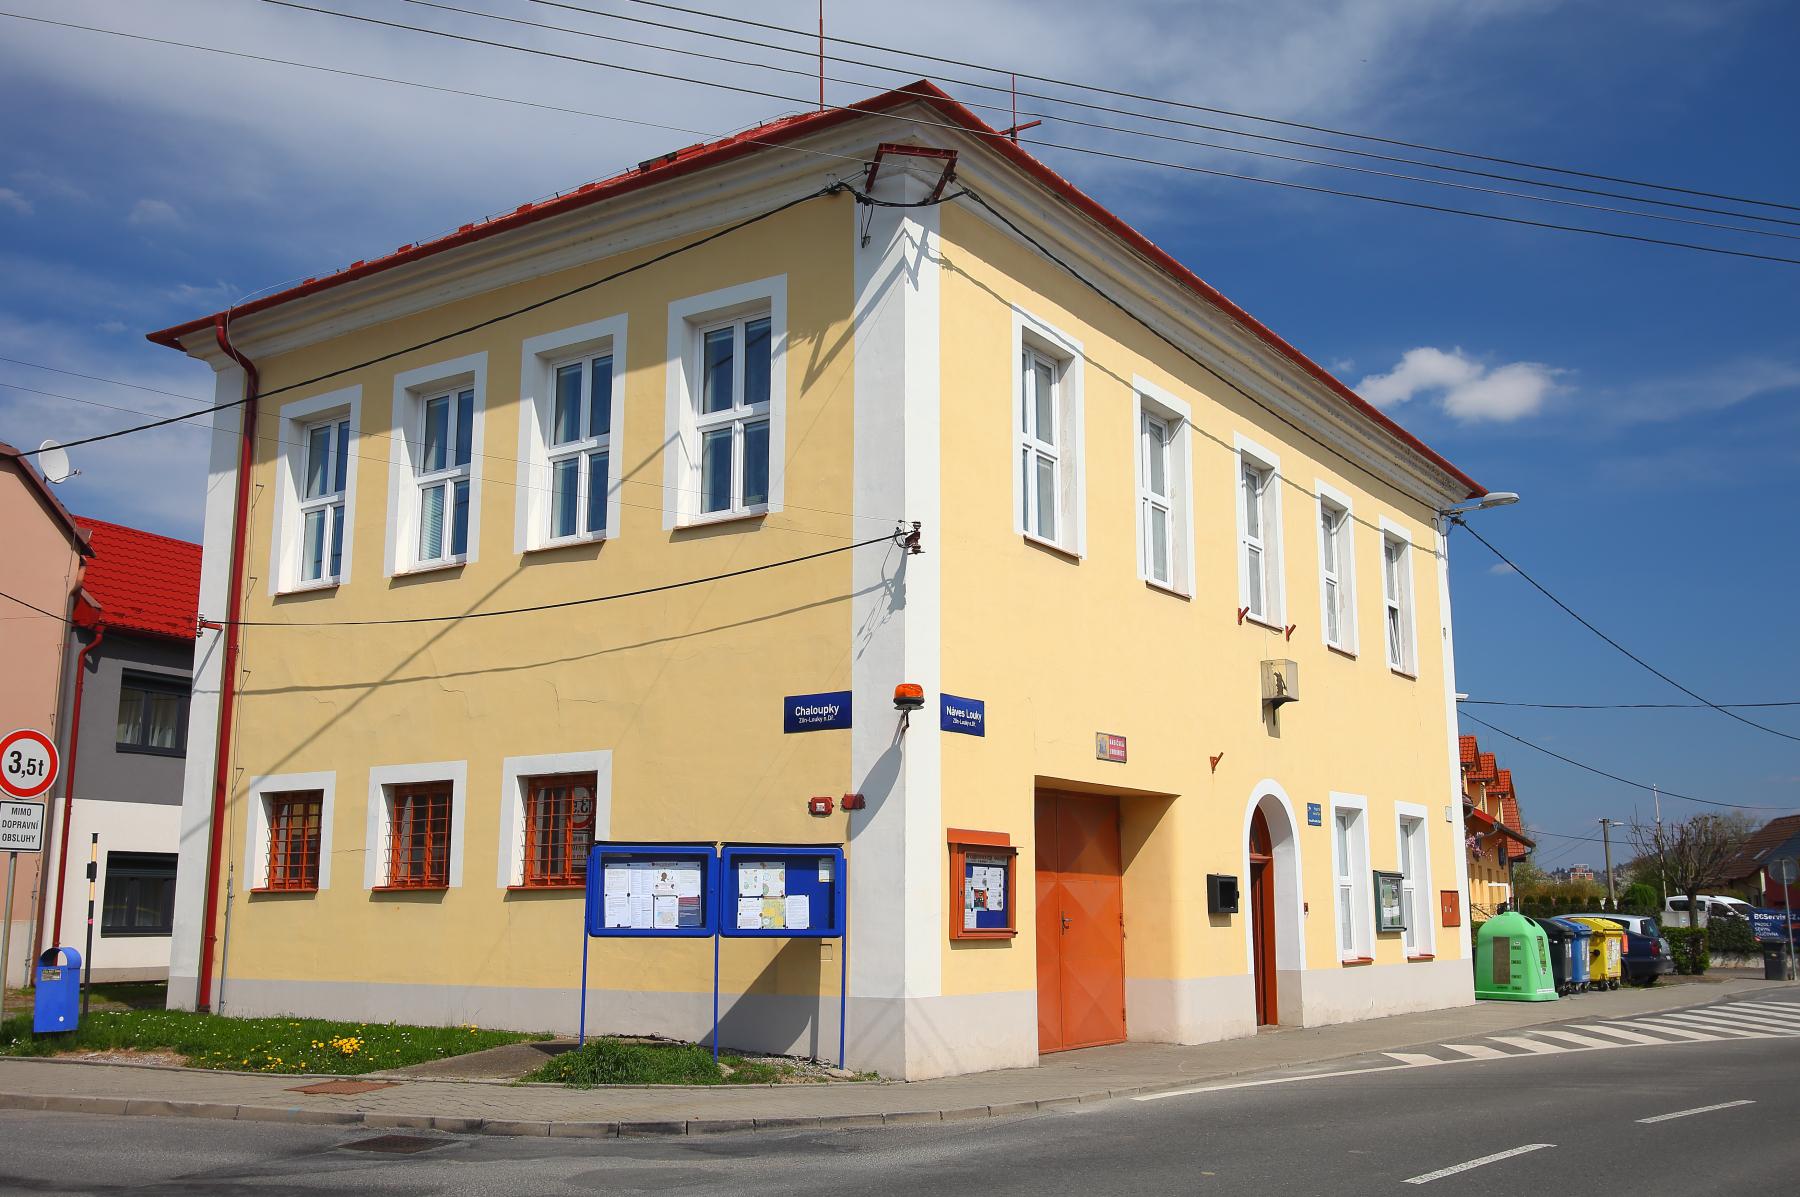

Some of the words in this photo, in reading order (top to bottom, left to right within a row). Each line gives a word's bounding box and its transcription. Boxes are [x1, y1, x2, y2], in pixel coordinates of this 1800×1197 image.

[795, 704, 839, 716] Chaloupky
[946, 705, 965, 717] Náves
[966, 708, 982, 723] Louky
[11, 807, 32, 817] MIMO
[2, 820, 39, 830] DOPRAVNÍ
[2, 833, 37, 843] OBSLUHY
